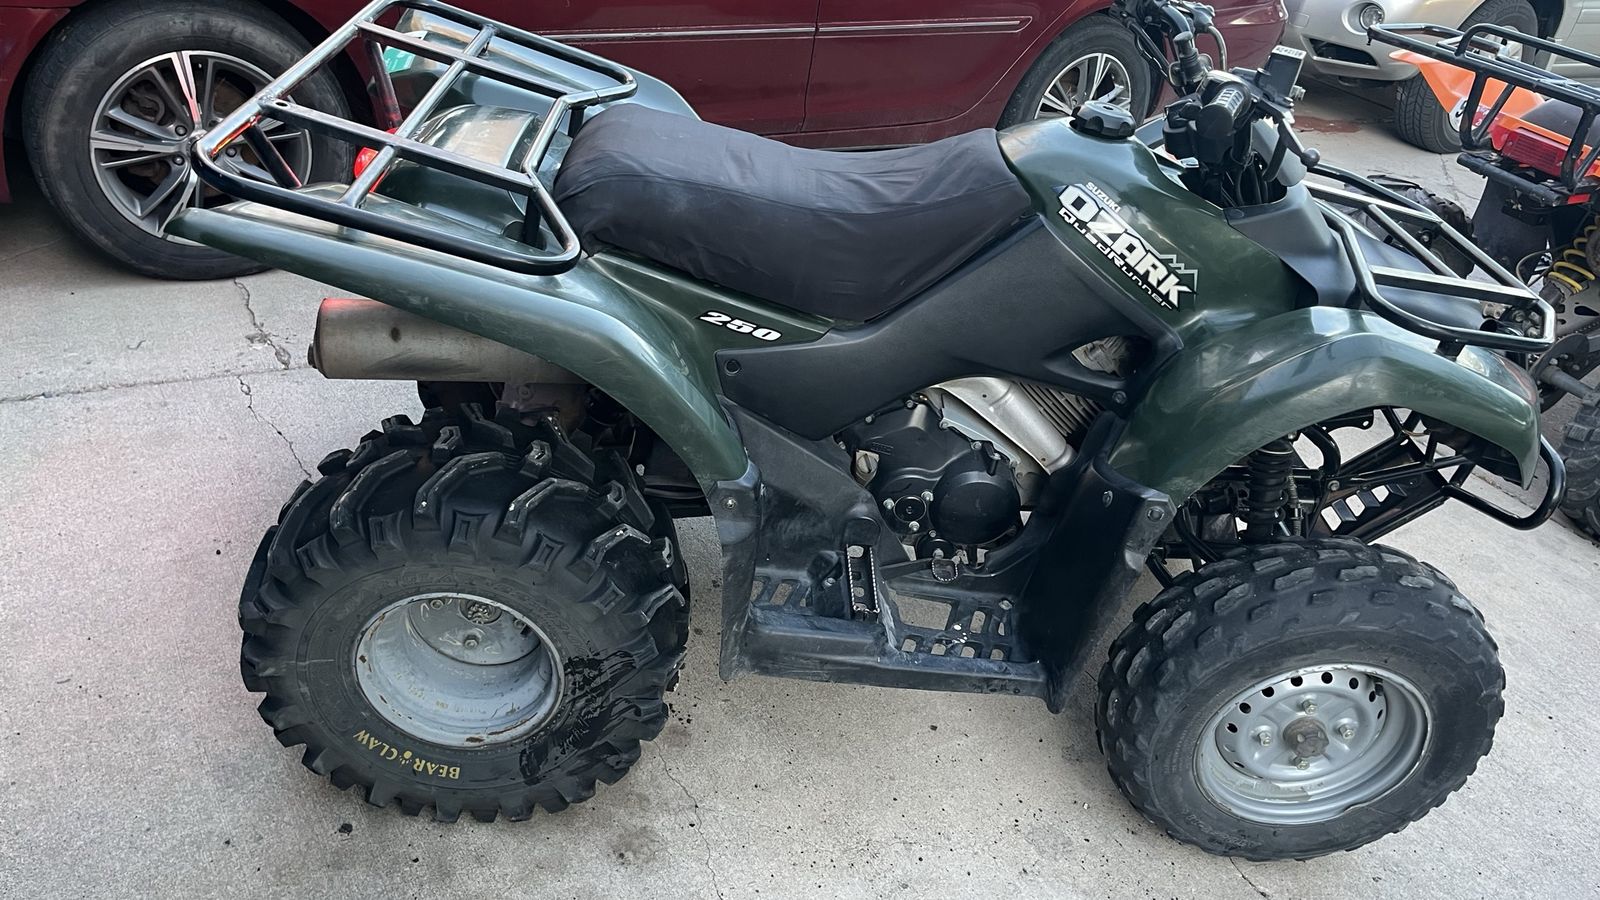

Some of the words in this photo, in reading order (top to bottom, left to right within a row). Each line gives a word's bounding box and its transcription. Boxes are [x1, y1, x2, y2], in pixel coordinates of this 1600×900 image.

[1085, 181, 1121, 213] SUZUKI
[1058, 184, 1193, 308] OZARK
[699, 311, 782, 341] 250
[352, 729, 399, 760] CLAW
[413, 758, 460, 779] BEAR
